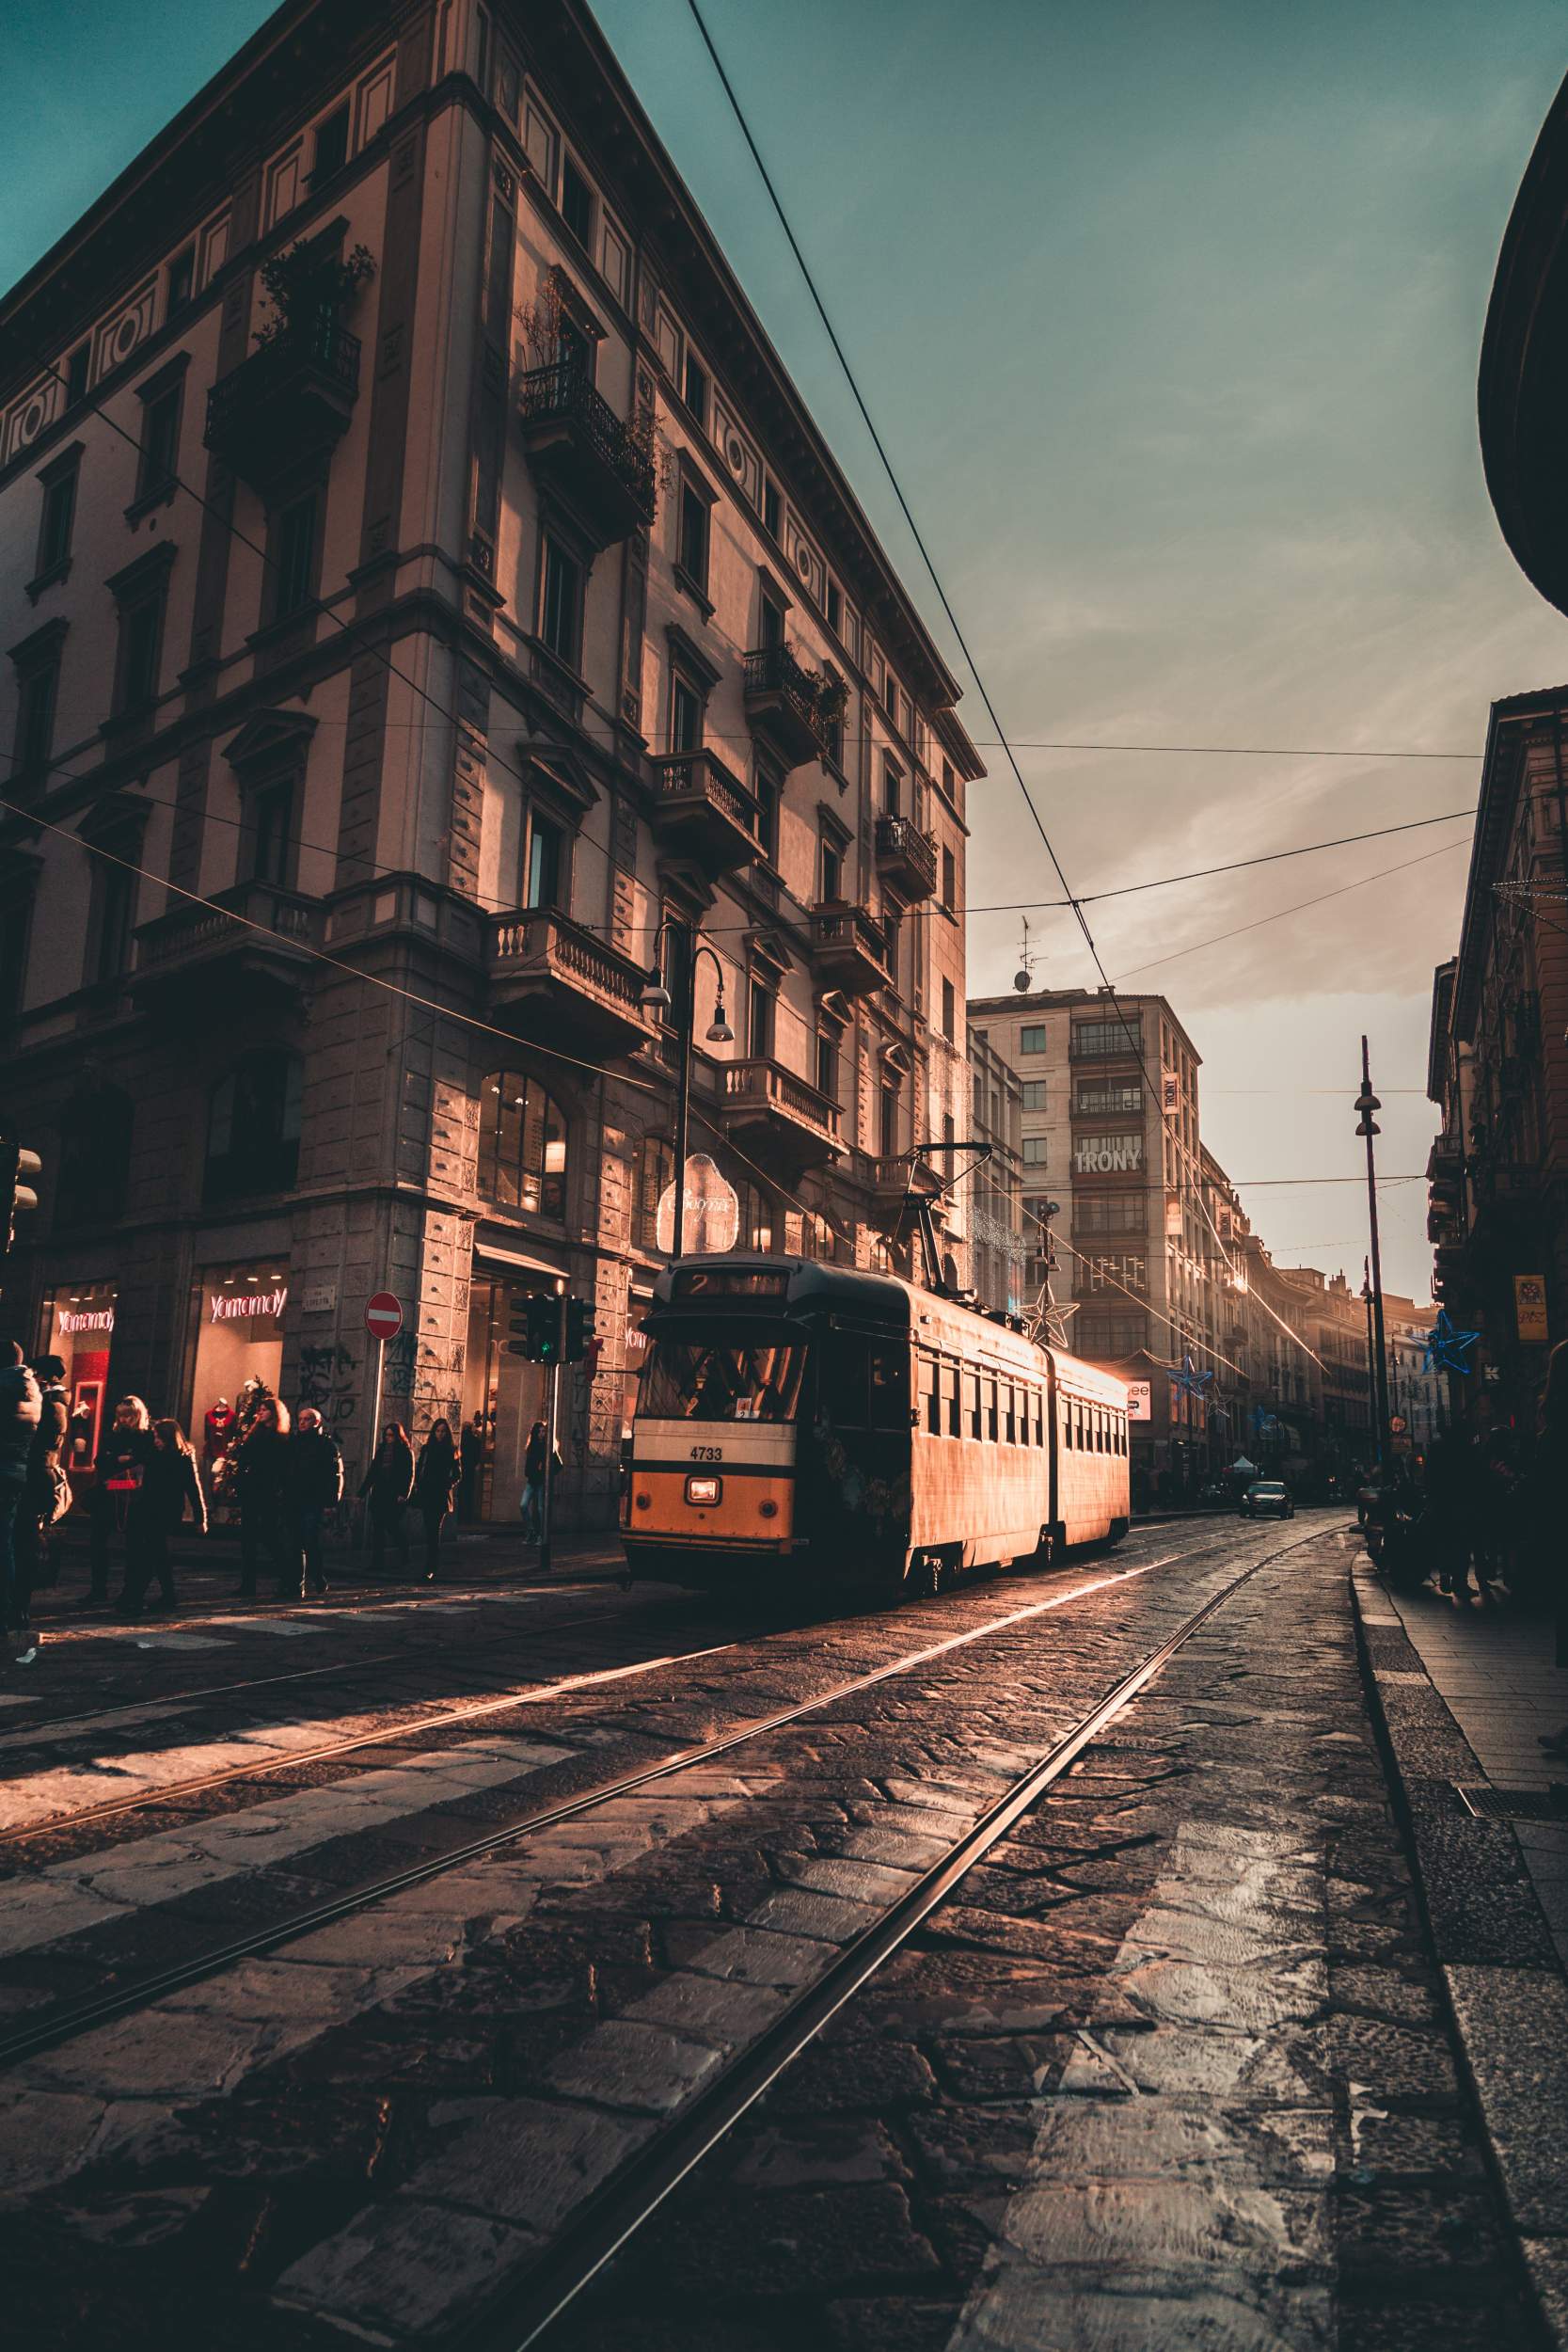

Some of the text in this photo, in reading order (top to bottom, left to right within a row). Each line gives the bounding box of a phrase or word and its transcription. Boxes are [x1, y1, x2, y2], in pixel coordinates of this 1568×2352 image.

[1165, 1080, 1176, 1107] TRONY
[1074, 1149, 1142, 1173] TRONY
[690, 1273, 708, 1295] 2
[690, 1446, 722, 1461] 4733
